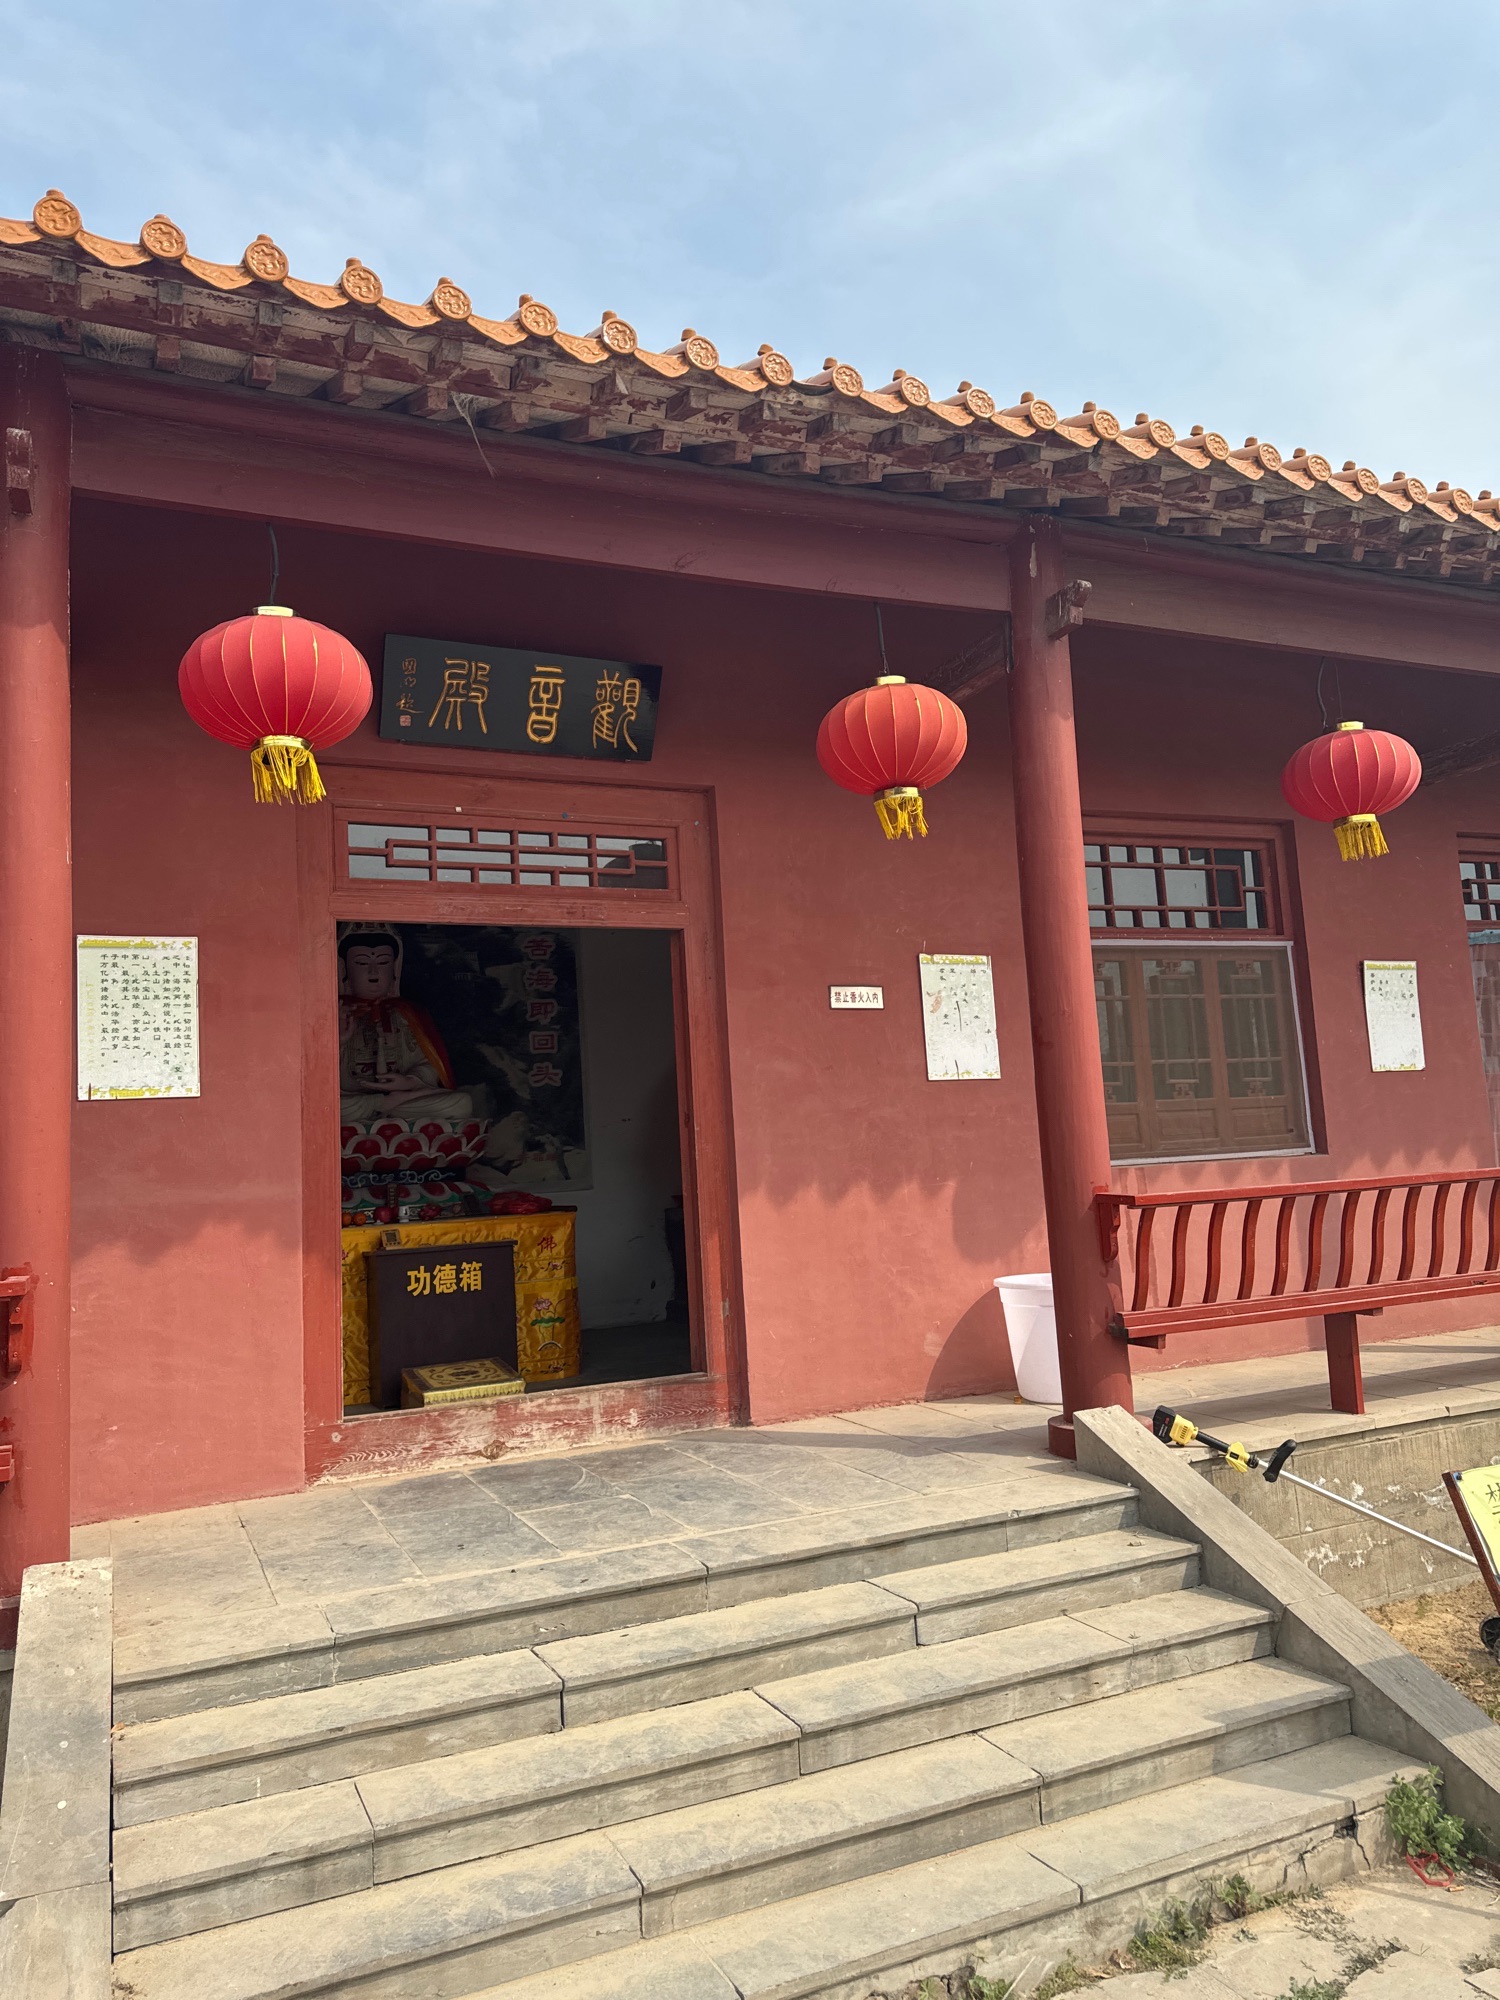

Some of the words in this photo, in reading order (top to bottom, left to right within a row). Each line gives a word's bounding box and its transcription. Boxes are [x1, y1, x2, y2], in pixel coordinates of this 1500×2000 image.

[523, 937, 562, 1086] 苦海即回头
[834, 991, 879, 1004] 禁止香火入内
[537, 1235, 558, 1254] 佛
[406, 1260, 483, 1297] 功德箱
